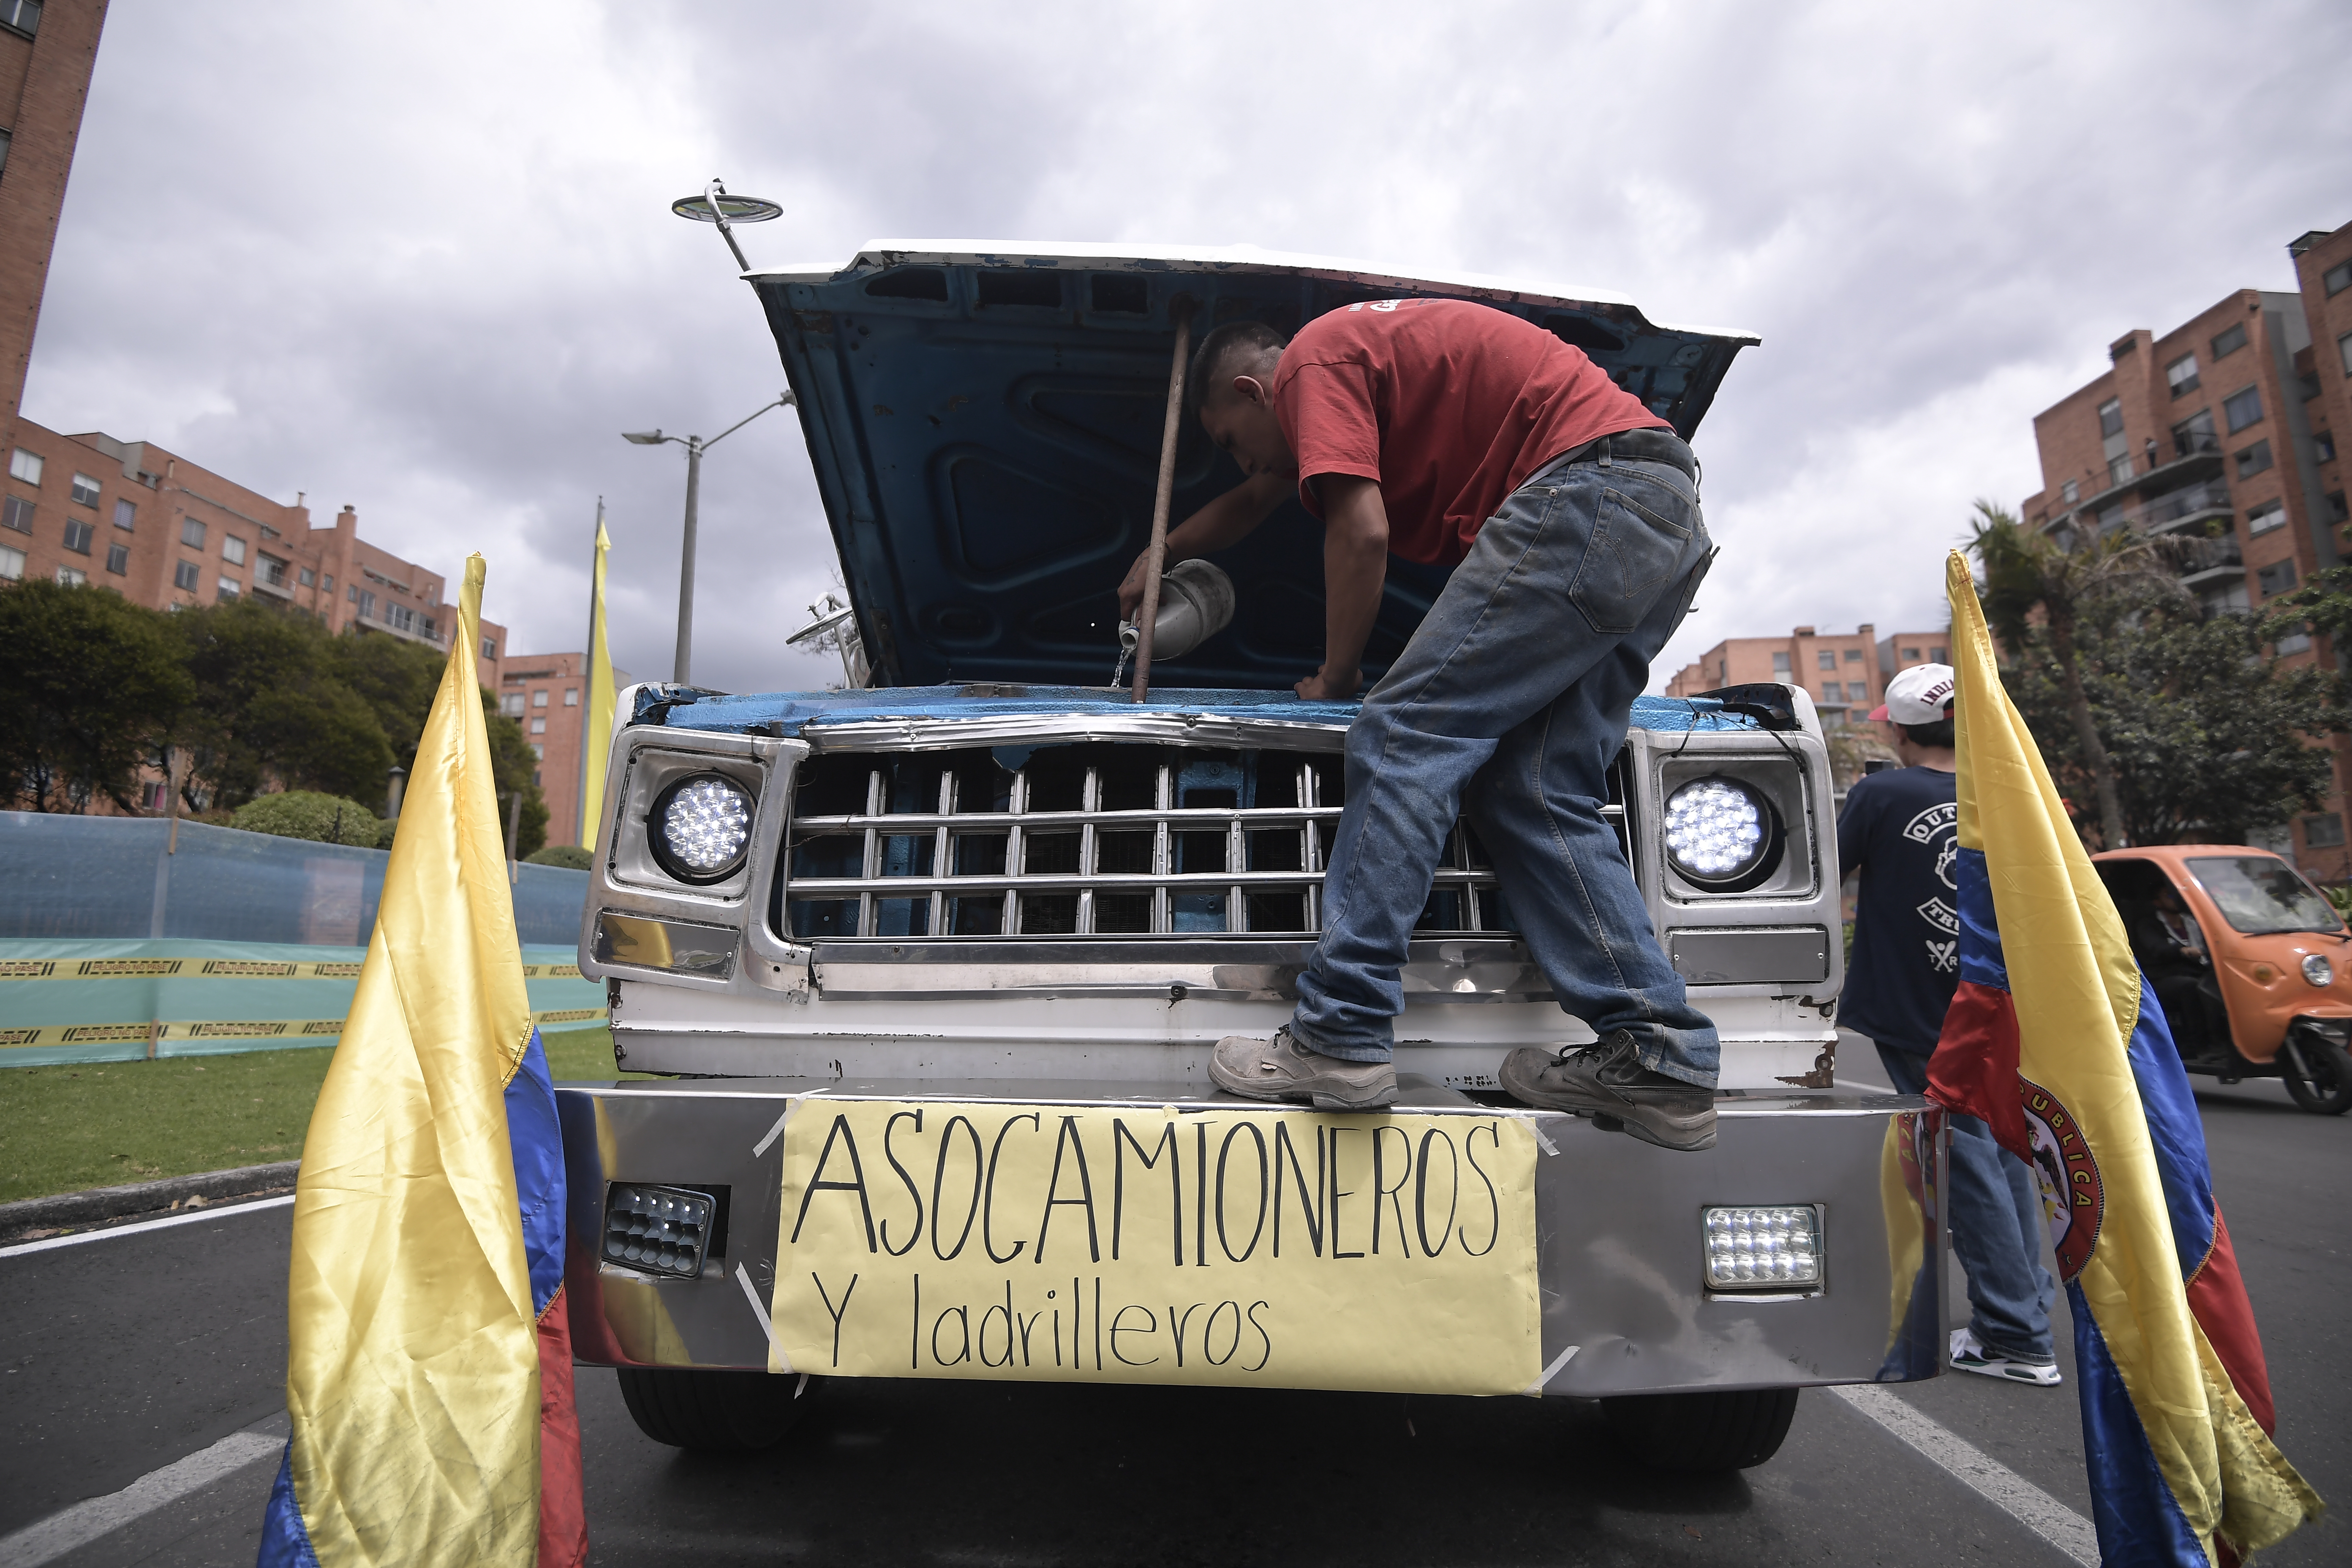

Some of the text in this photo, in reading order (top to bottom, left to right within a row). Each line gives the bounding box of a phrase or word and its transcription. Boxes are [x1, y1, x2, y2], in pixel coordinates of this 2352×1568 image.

[791, 1109, 1499, 1266] ASOCAMIONEROS
[812, 1272, 1271, 1372] Y ladrilleros
